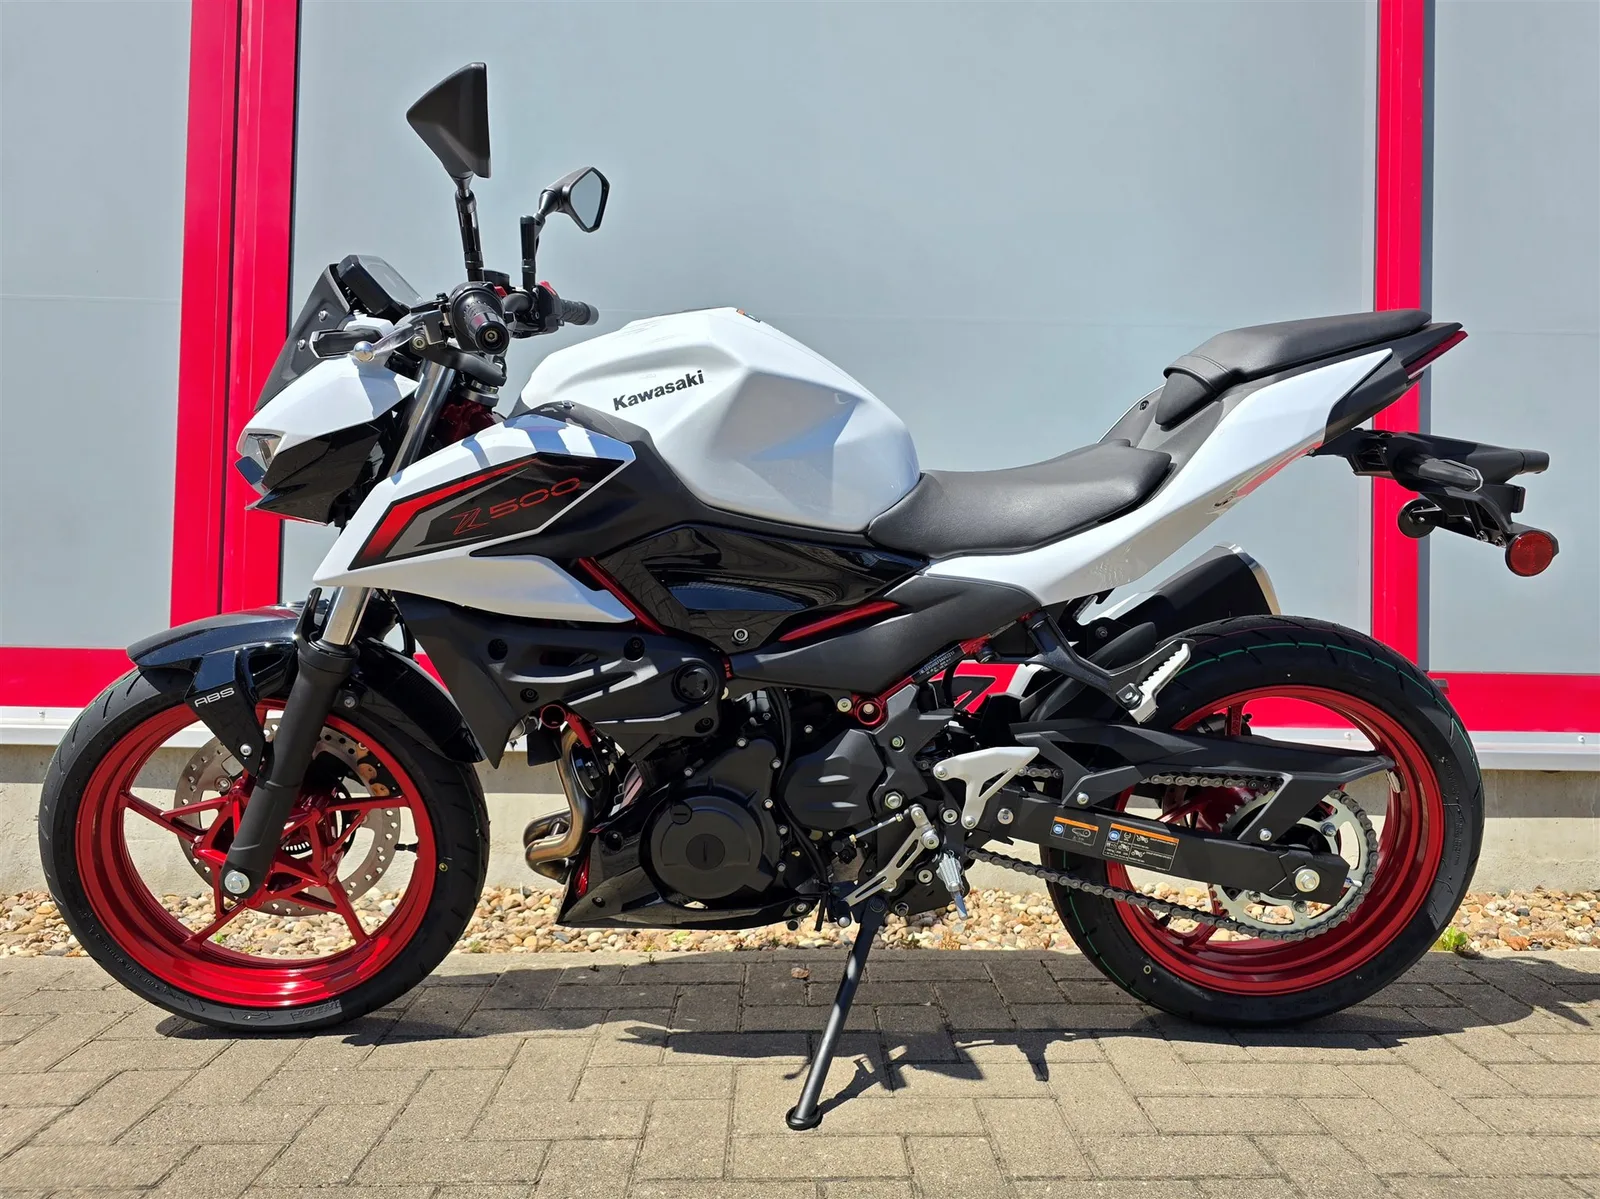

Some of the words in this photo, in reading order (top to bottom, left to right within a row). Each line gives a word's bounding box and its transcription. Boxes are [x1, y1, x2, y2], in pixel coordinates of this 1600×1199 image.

[613, 370, 704, 411] Kawasaki
[450, 507, 489, 536] Z
[489, 477, 581, 519] 500
[194, 687, 235, 708] ABS
